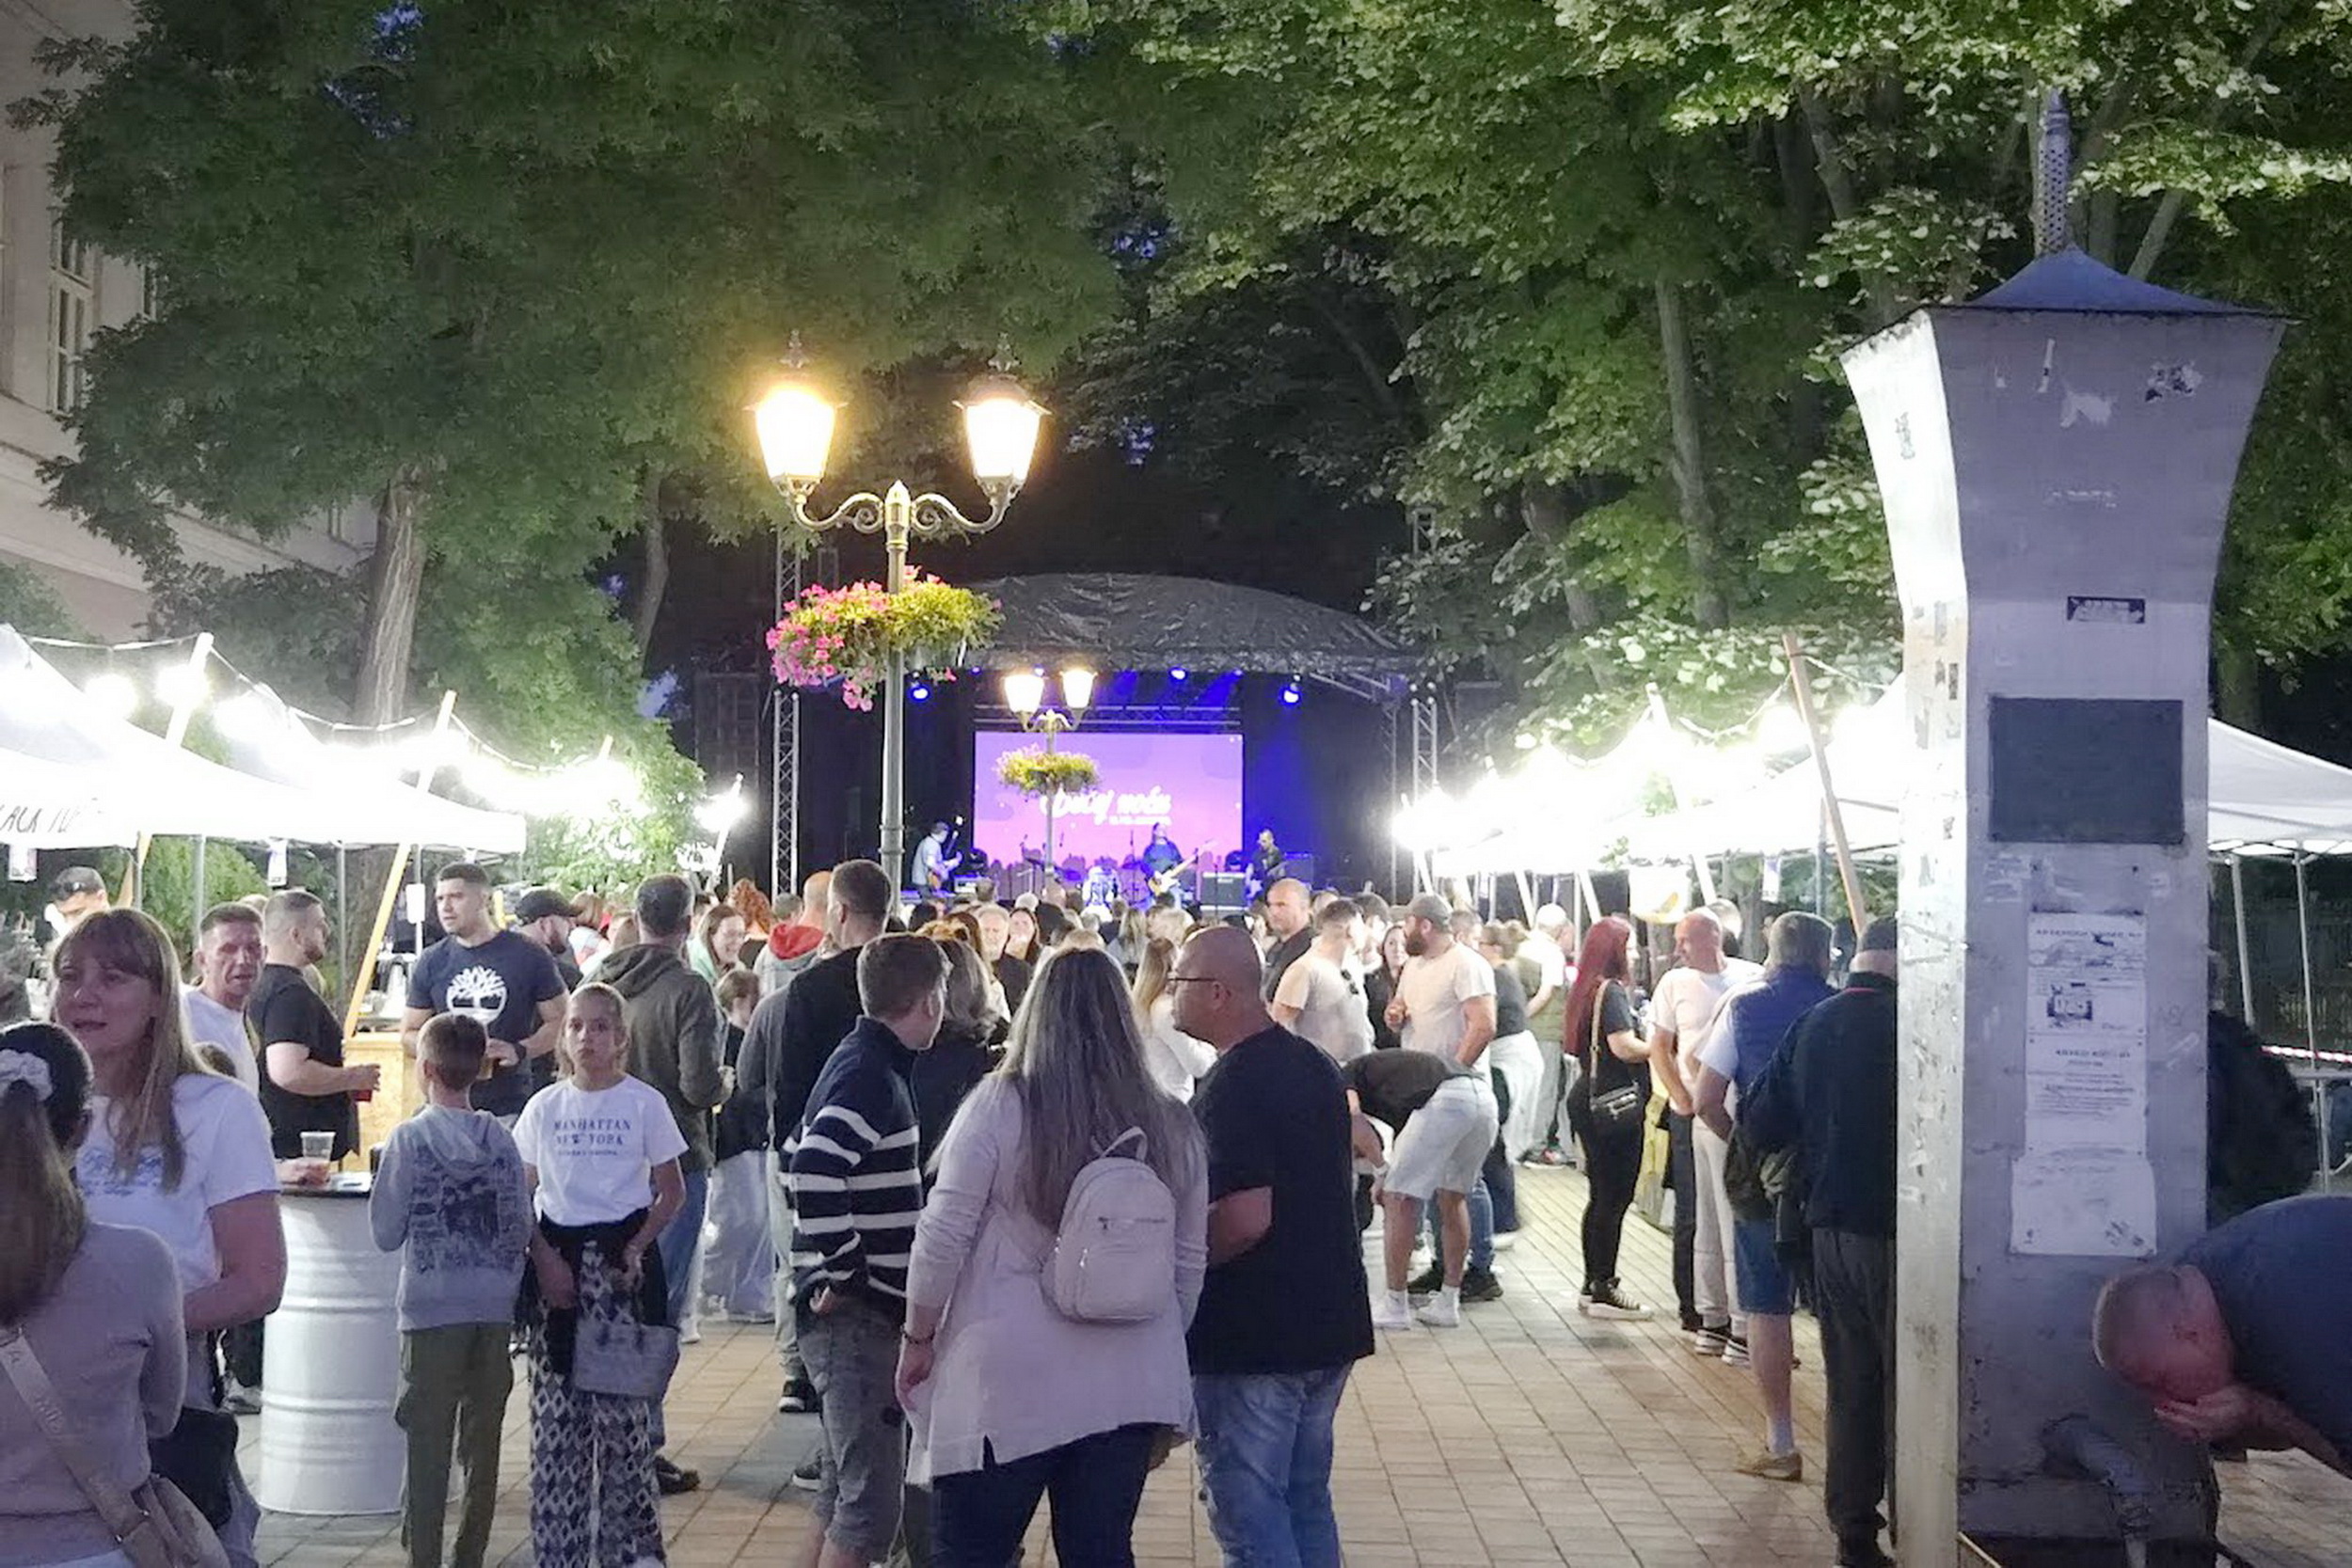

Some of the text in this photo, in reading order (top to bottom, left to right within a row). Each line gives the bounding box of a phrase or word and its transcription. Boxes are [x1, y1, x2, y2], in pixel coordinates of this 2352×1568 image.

[554, 1118, 631, 1131] MANHATTAN
[556, 1133, 625, 1146] NEW YORK
